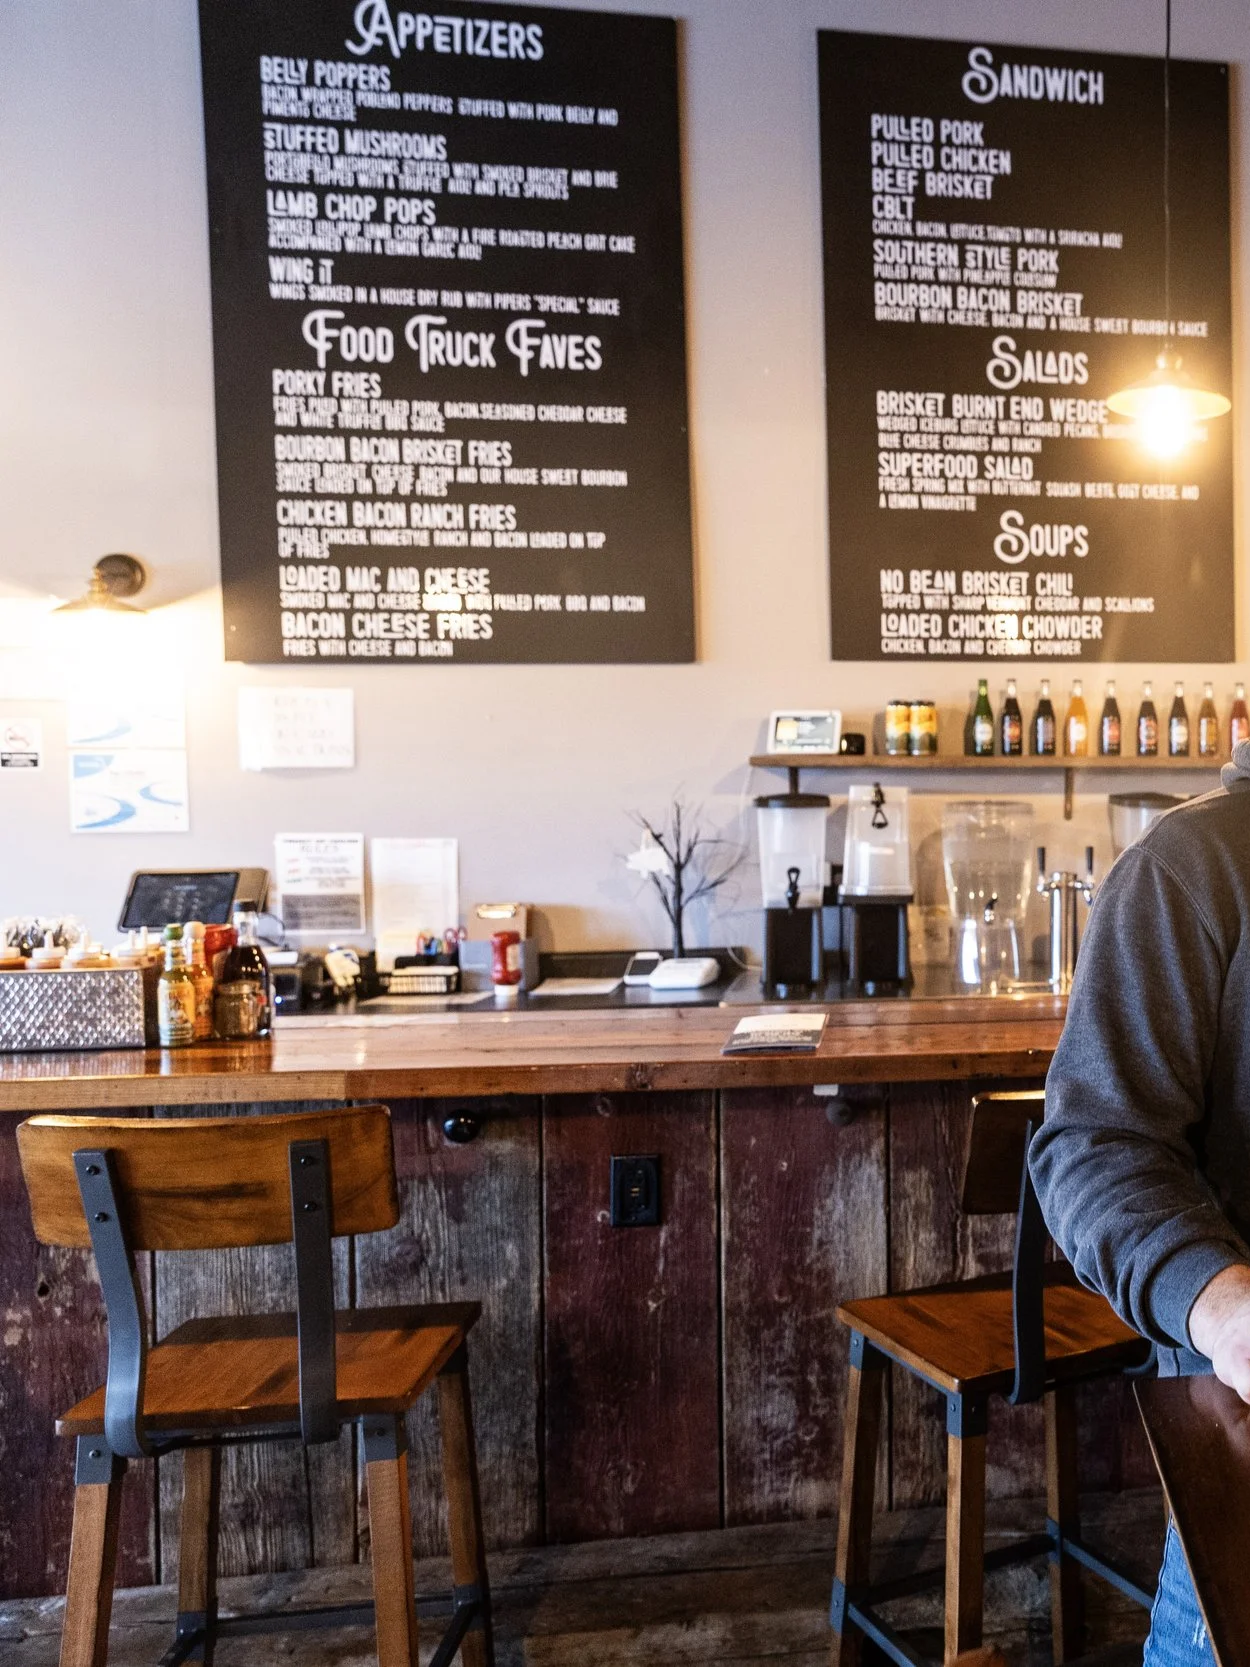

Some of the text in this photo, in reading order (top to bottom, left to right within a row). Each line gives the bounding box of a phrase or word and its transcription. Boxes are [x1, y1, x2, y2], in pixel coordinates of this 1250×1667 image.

[345, 0, 543, 60] APPETIZERS
[260, 56, 391, 92] BELLY POPPERS
[962, 47, 1103, 104] SANDWICH
[263, 122, 447, 161] STUFFED MUSHROOMS
[870, 113, 984, 147] PULLED PORK
[870, 141, 1011, 175] PULLED CHICKEN
[872, 167, 994, 200] BEEF BRISKET
[267, 190, 436, 225] LAMB CHOP POPS
[872, 194, 915, 220] CBLT
[268, 255, 314, 284] WING
[873, 239, 1059, 273] SOUTHERN STYLE PORK
[269, 282, 305, 300] WINGS
[307, 284, 353, 303] SMOKED
[355, 286, 367, 303] IN
[370, 287, 378, 304] A
[380, 287, 416, 306] HOUSE
[417, 289, 439, 307] DRY
[441, 290, 463, 308] RUB
[464, 291, 492, 310] WITH
[587, 297, 620, 316] SAUCE
[874, 281, 1084, 316] BOURBON BACON BRISKET
[302, 308, 602, 377] FOOD TRUCK FAVES
[986, 335, 1088, 390] SALADS
[272, 368, 382, 399] PORKY FRIES
[876, 390, 1108, 424] BRISKET BURNT END WEDGE
[274, 434, 512, 467] BOURBON BACON BRISKET FRIES
[878, 452, 1034, 481] SUPERFOOD SALAD
[276, 499, 517, 531] CHICKEN BACON RANCH FRIES
[994, 510, 1089, 564] SOUPS
[279, 564, 490, 595] LOADED MAC AND CHEESE
[880, 569, 904, 594] NO
[909, 569, 956, 595] BEAN
[962, 570, 1030, 596] BRISKET
[281, 611, 493, 640] BACON CHEESE FRIES
[880, 612, 1103, 640] LOADED CHICKEN CHOWDER
[282, 638, 453, 656] FRIES WITH CHEESE AND BACON
[928, 638, 961, 654] BACON
[964, 639, 984, 655] AND
